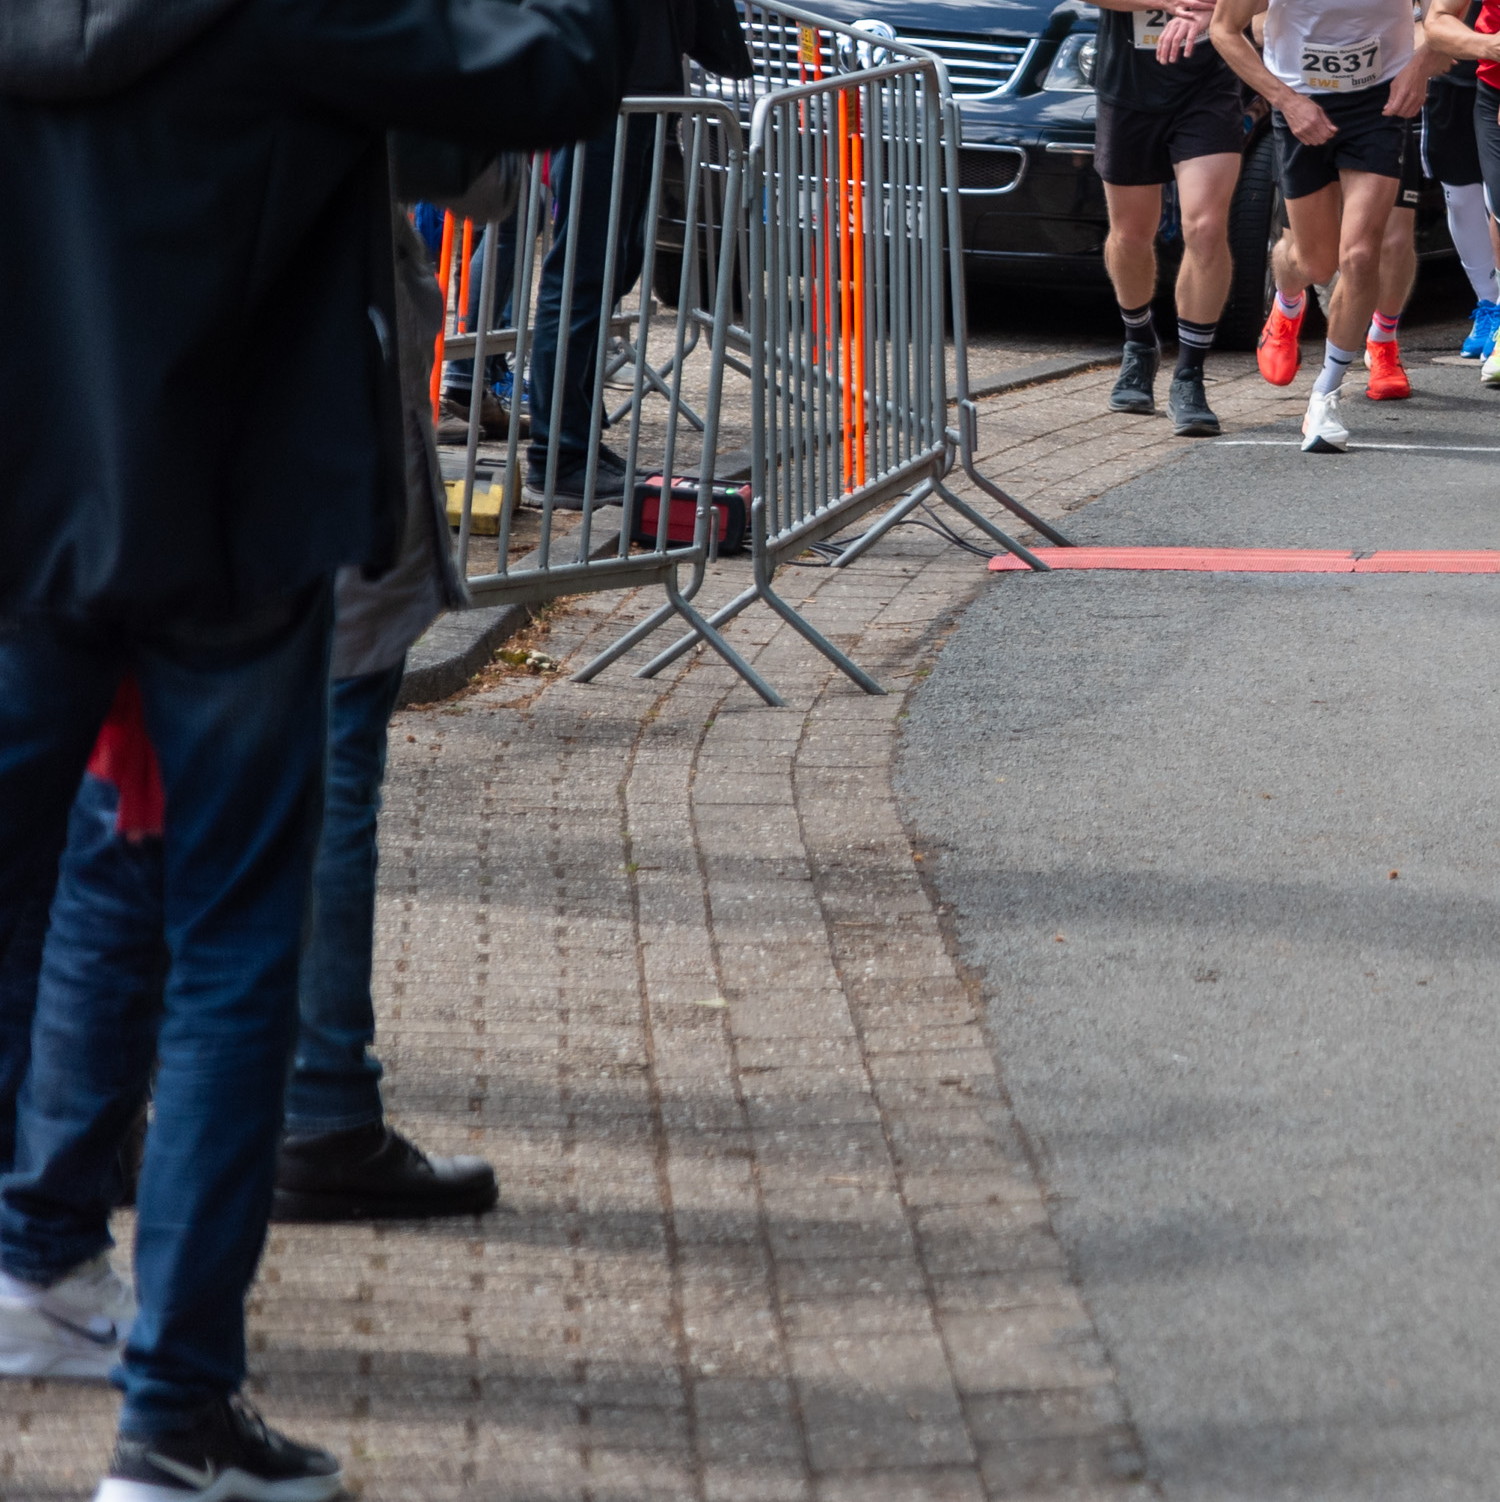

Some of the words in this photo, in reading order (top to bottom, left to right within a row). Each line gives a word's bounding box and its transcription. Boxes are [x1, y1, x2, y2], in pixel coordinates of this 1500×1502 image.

[1302, 46, 1378, 73] 2637
[1309, 77, 1339, 88] EWE
[1351, 73, 1376, 86] bruns
